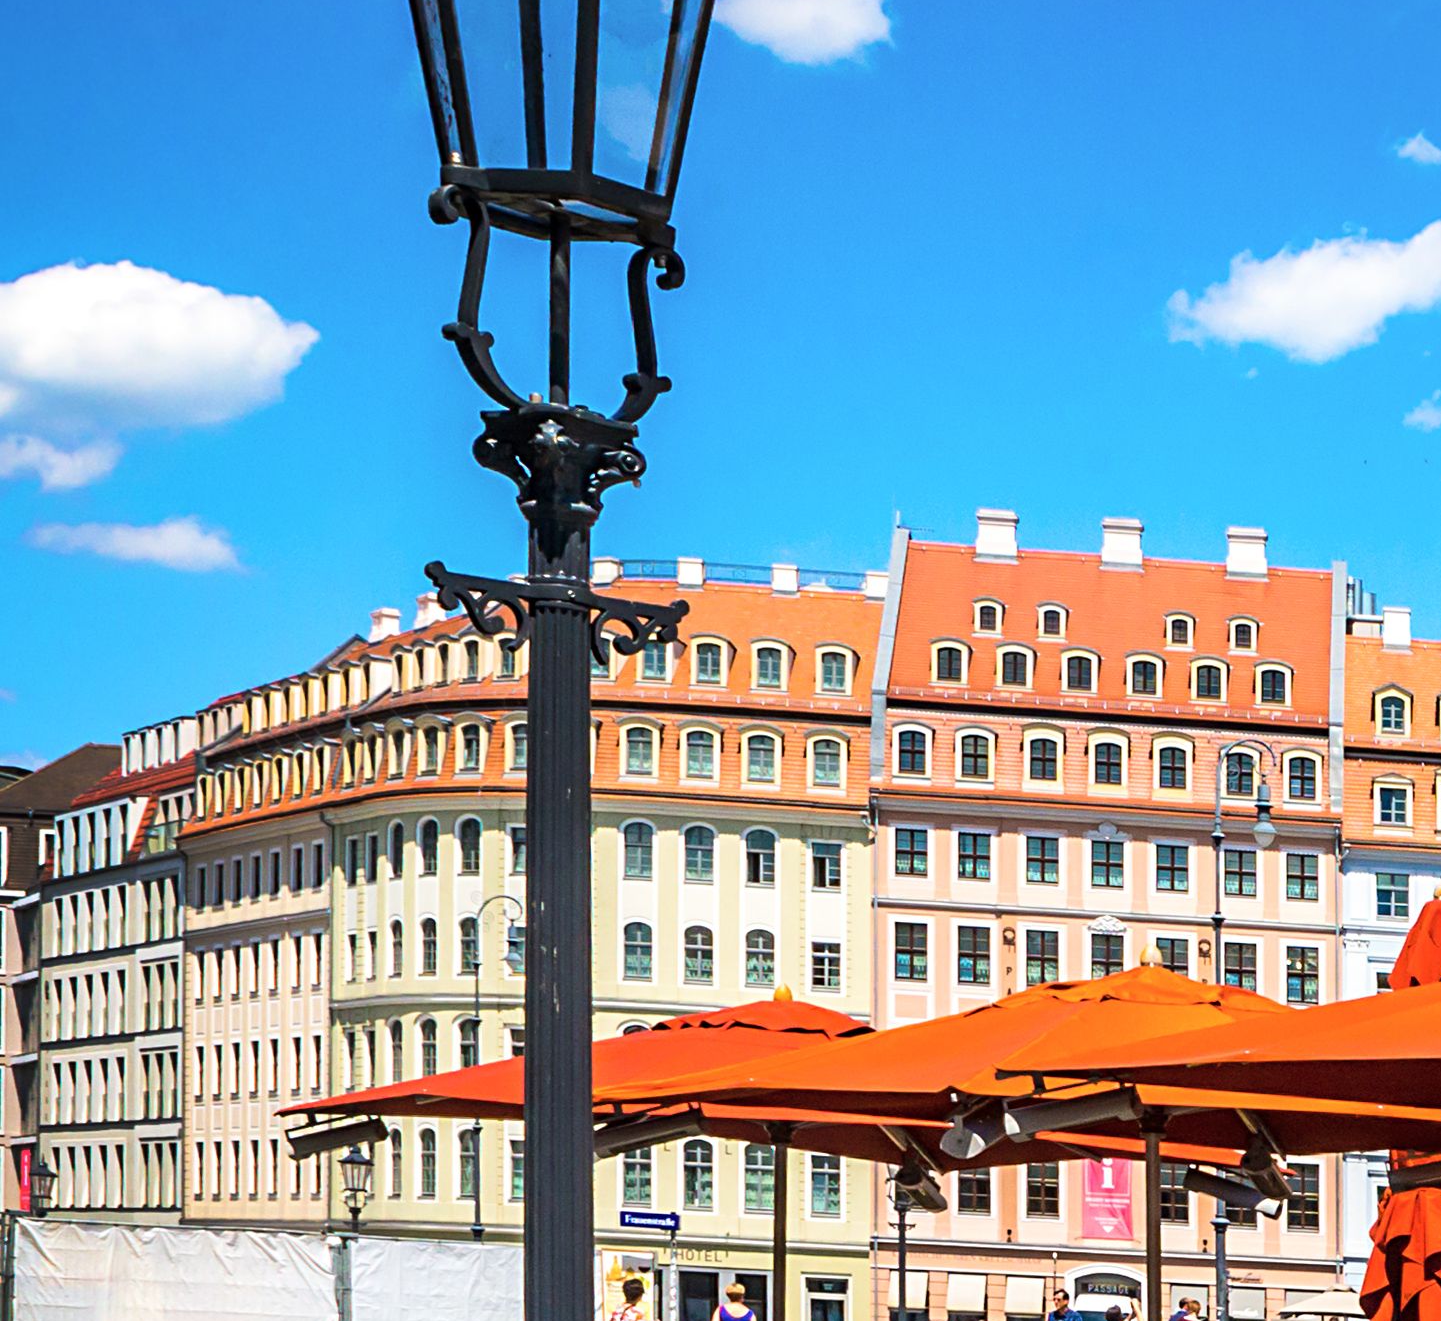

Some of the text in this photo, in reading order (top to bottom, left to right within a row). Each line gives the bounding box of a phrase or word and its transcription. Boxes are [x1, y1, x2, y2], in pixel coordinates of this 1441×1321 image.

[625, 1214, 675, 1227] Frauenstraße
[675, 1249, 722, 1262] HOTEL
[1087, 1283, 1130, 1295] PASSAGE
